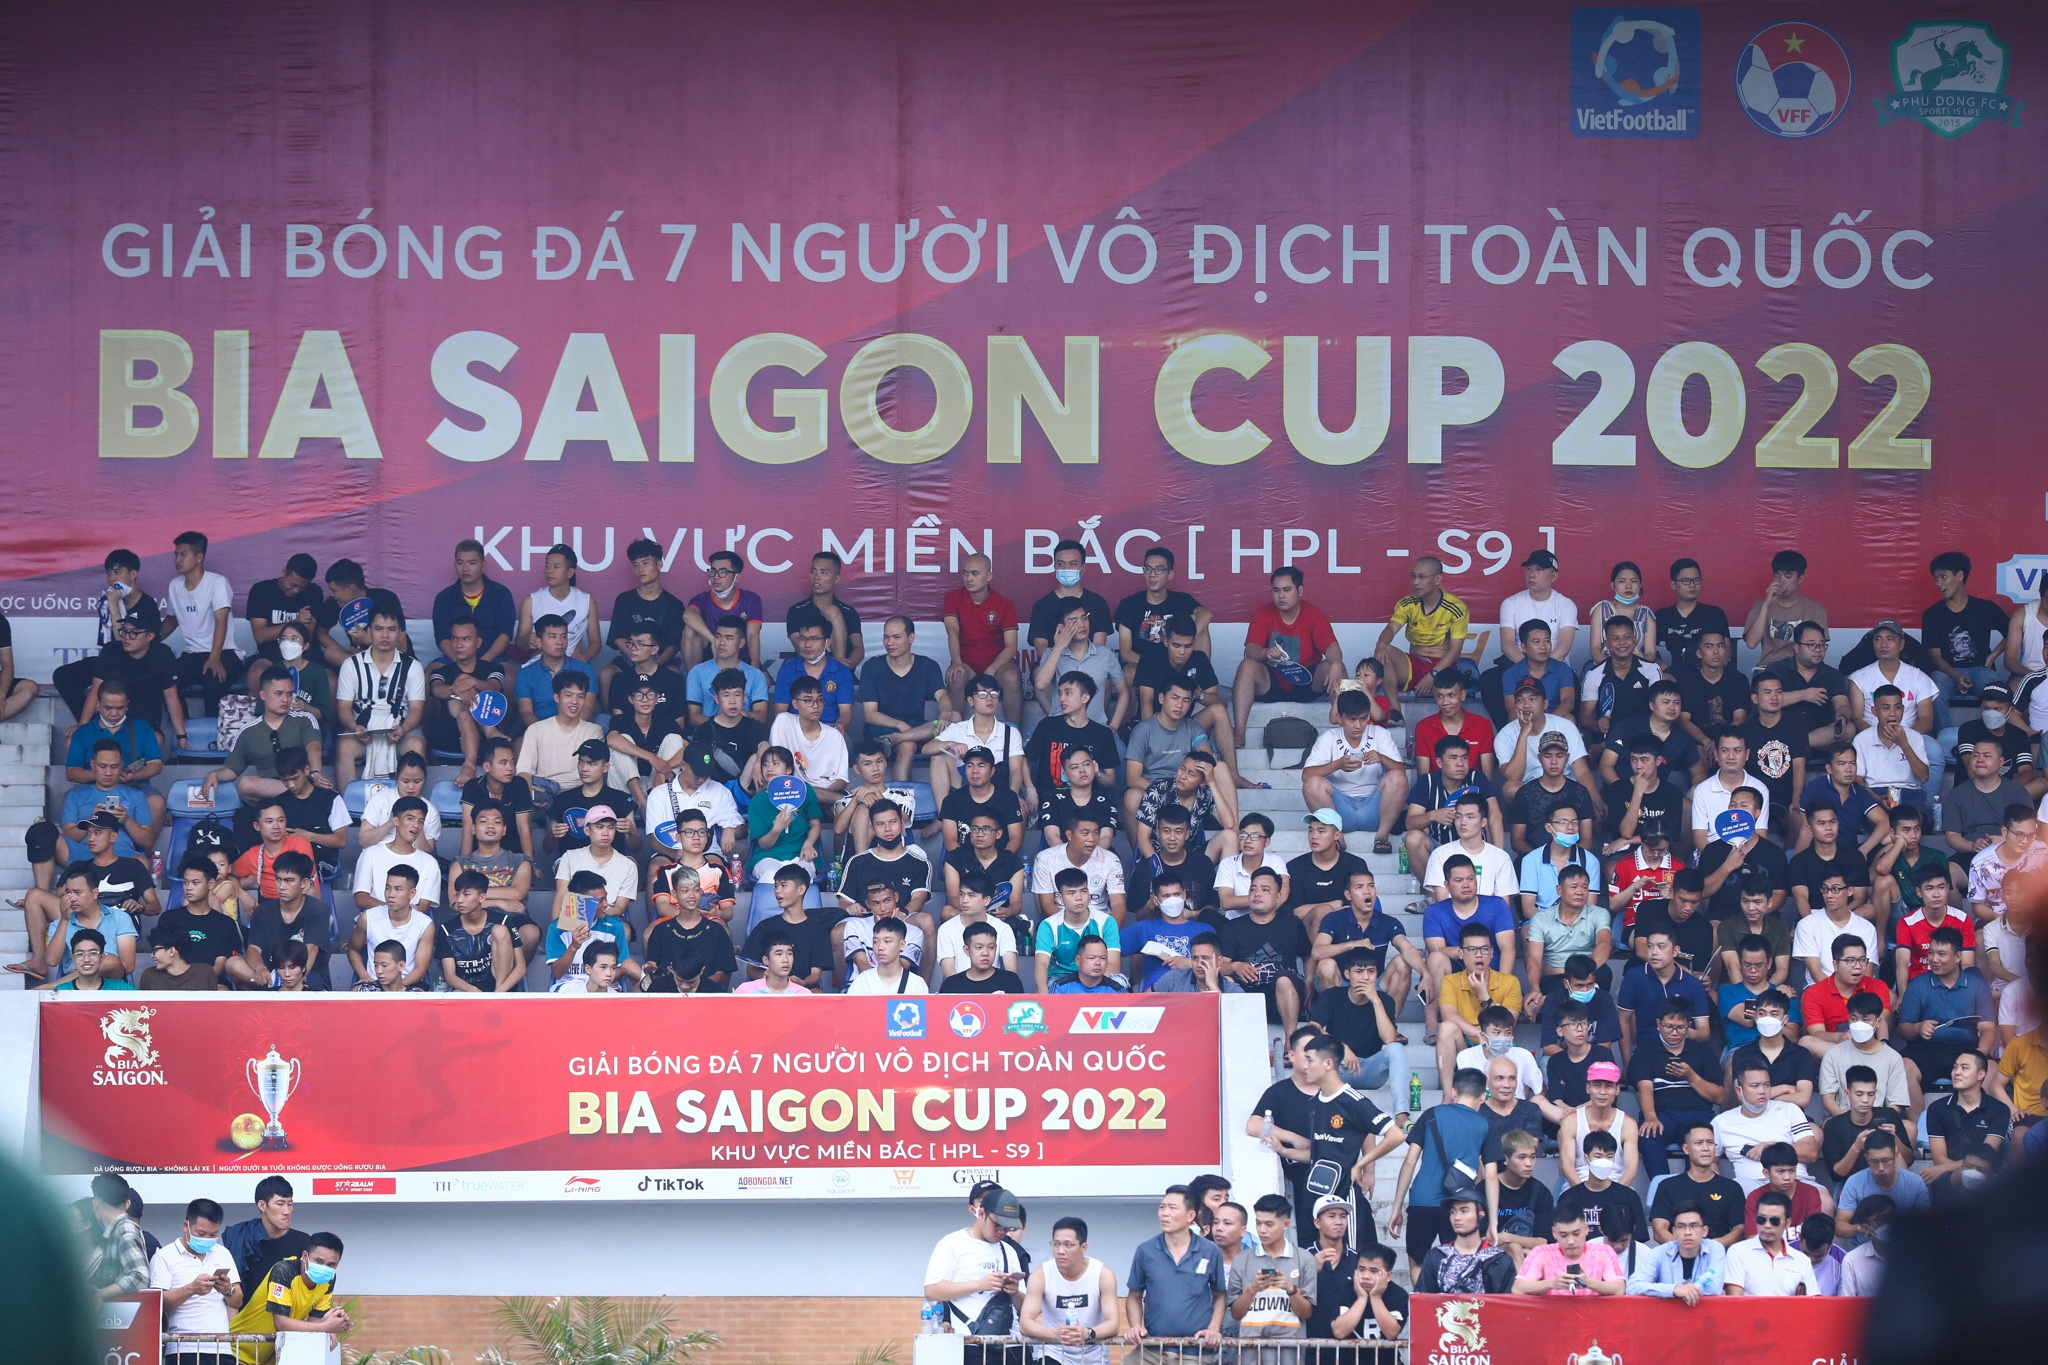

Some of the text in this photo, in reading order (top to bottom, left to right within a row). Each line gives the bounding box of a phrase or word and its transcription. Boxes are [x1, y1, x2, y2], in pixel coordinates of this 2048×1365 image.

[1902, 96, 1996, 109] PHU DONG FC
[1576, 108, 1687, 131] VietFootball
[1777, 109, 1811, 124] VFF
[1938, 119, 1961, 127] 2015
[102, 205, 1935, 304] GIẢI BÓNG ĐÁ 7 NGƯỜI VÔ ĐỊCH TOÀN QUỐC
[98, 328, 1933, 470] BIA SAIGON CUP 2022
[474, 525, 615, 572] KHU
[822, 513, 993, 574] MIỀN
[1231, 529, 1361, 574] HPL
[1437, 528, 1513, 577] S9
[0, 596, 26, 614] ỢC
[888, 1029, 922, 1037] VietFootball
[117, 1060, 140, 1069] BIA
[568, 1044, 1166, 1079] GIẢI BÓNG ĐÁ 7 NGƯỜI VÔ ĐỊCH TOÀN QUỐC
[93, 1070, 164, 1086] SAIGON
[568, 1087, 1167, 1135] BIA SAIGON CUP 2022
[711, 1145, 756, 1161] KHU
[763, 1143, 810, 1164] VỰC
[818, 1140, 871, 1160] MIỀN
[879, 1139, 923, 1160] BẮC
[943, 1143, 984, 1159] HPL
[1006, 1143, 1030, 1159] S9
[105, 1164, 124, 1172] UỐNG
[126, 1165, 145, 1173] RƯỢU
[164, 1164, 187, 1172] KHÔNG
[189, 1164, 200, 1172] LÁI
[270, 1163, 285, 1171] TUỔI
[287, 1163, 310, 1171] KHÔNG
[312, 1164, 332, 1172] ĐƯỢC
[334, 1163, 353, 1171] UỐNG
[355, 1163, 374, 1172] RƯỢU
[433, 1181, 451, 1191] TH
[654, 1178, 704, 1191] TikTok
[1450, 1345, 1469, 1354] BIA
